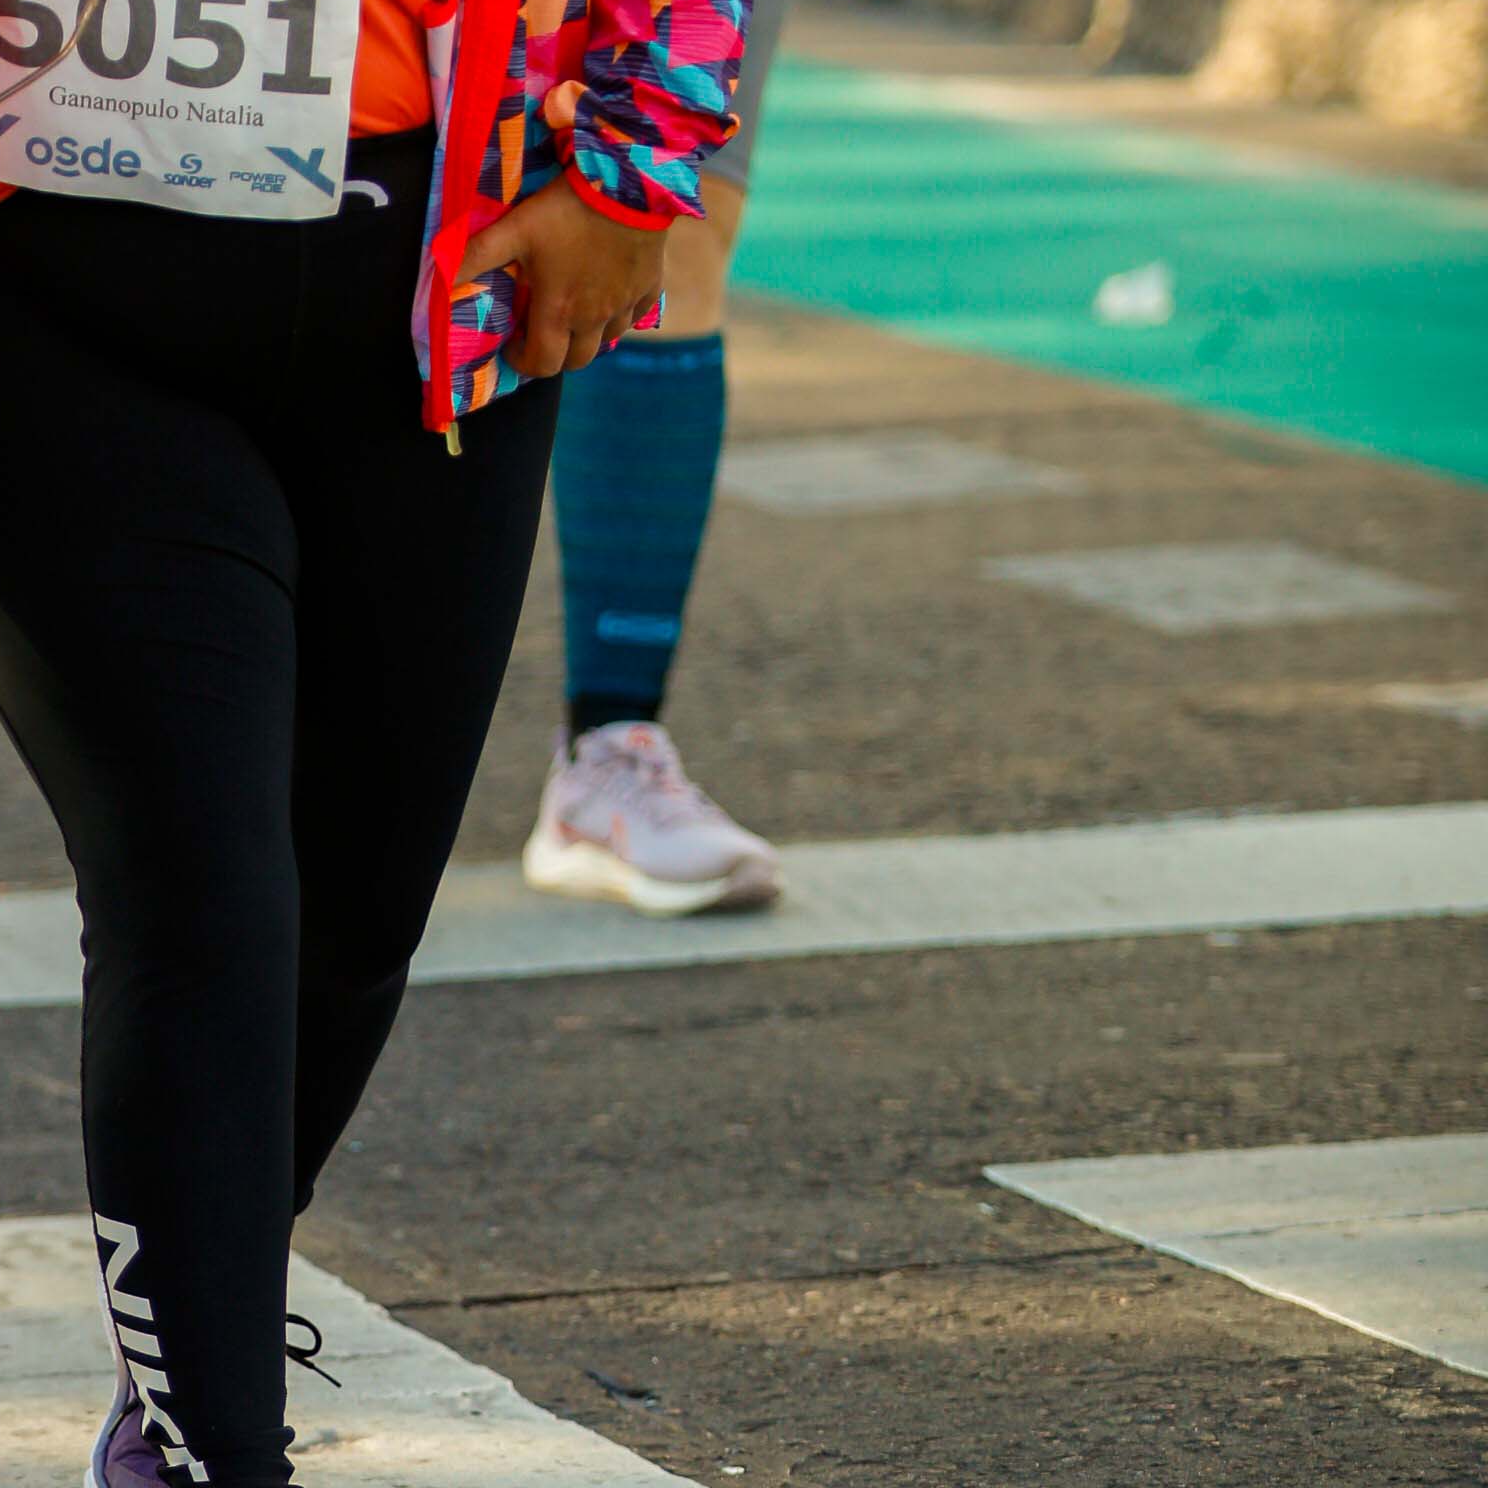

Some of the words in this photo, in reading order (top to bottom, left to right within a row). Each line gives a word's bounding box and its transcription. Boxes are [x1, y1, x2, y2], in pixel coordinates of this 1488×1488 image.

[48, 86, 179, 120] Gananopulo
[186, 101, 265, 127] Natalia
[25, 136, 142, 178] osde
[229, 171, 287, 184] POWER
